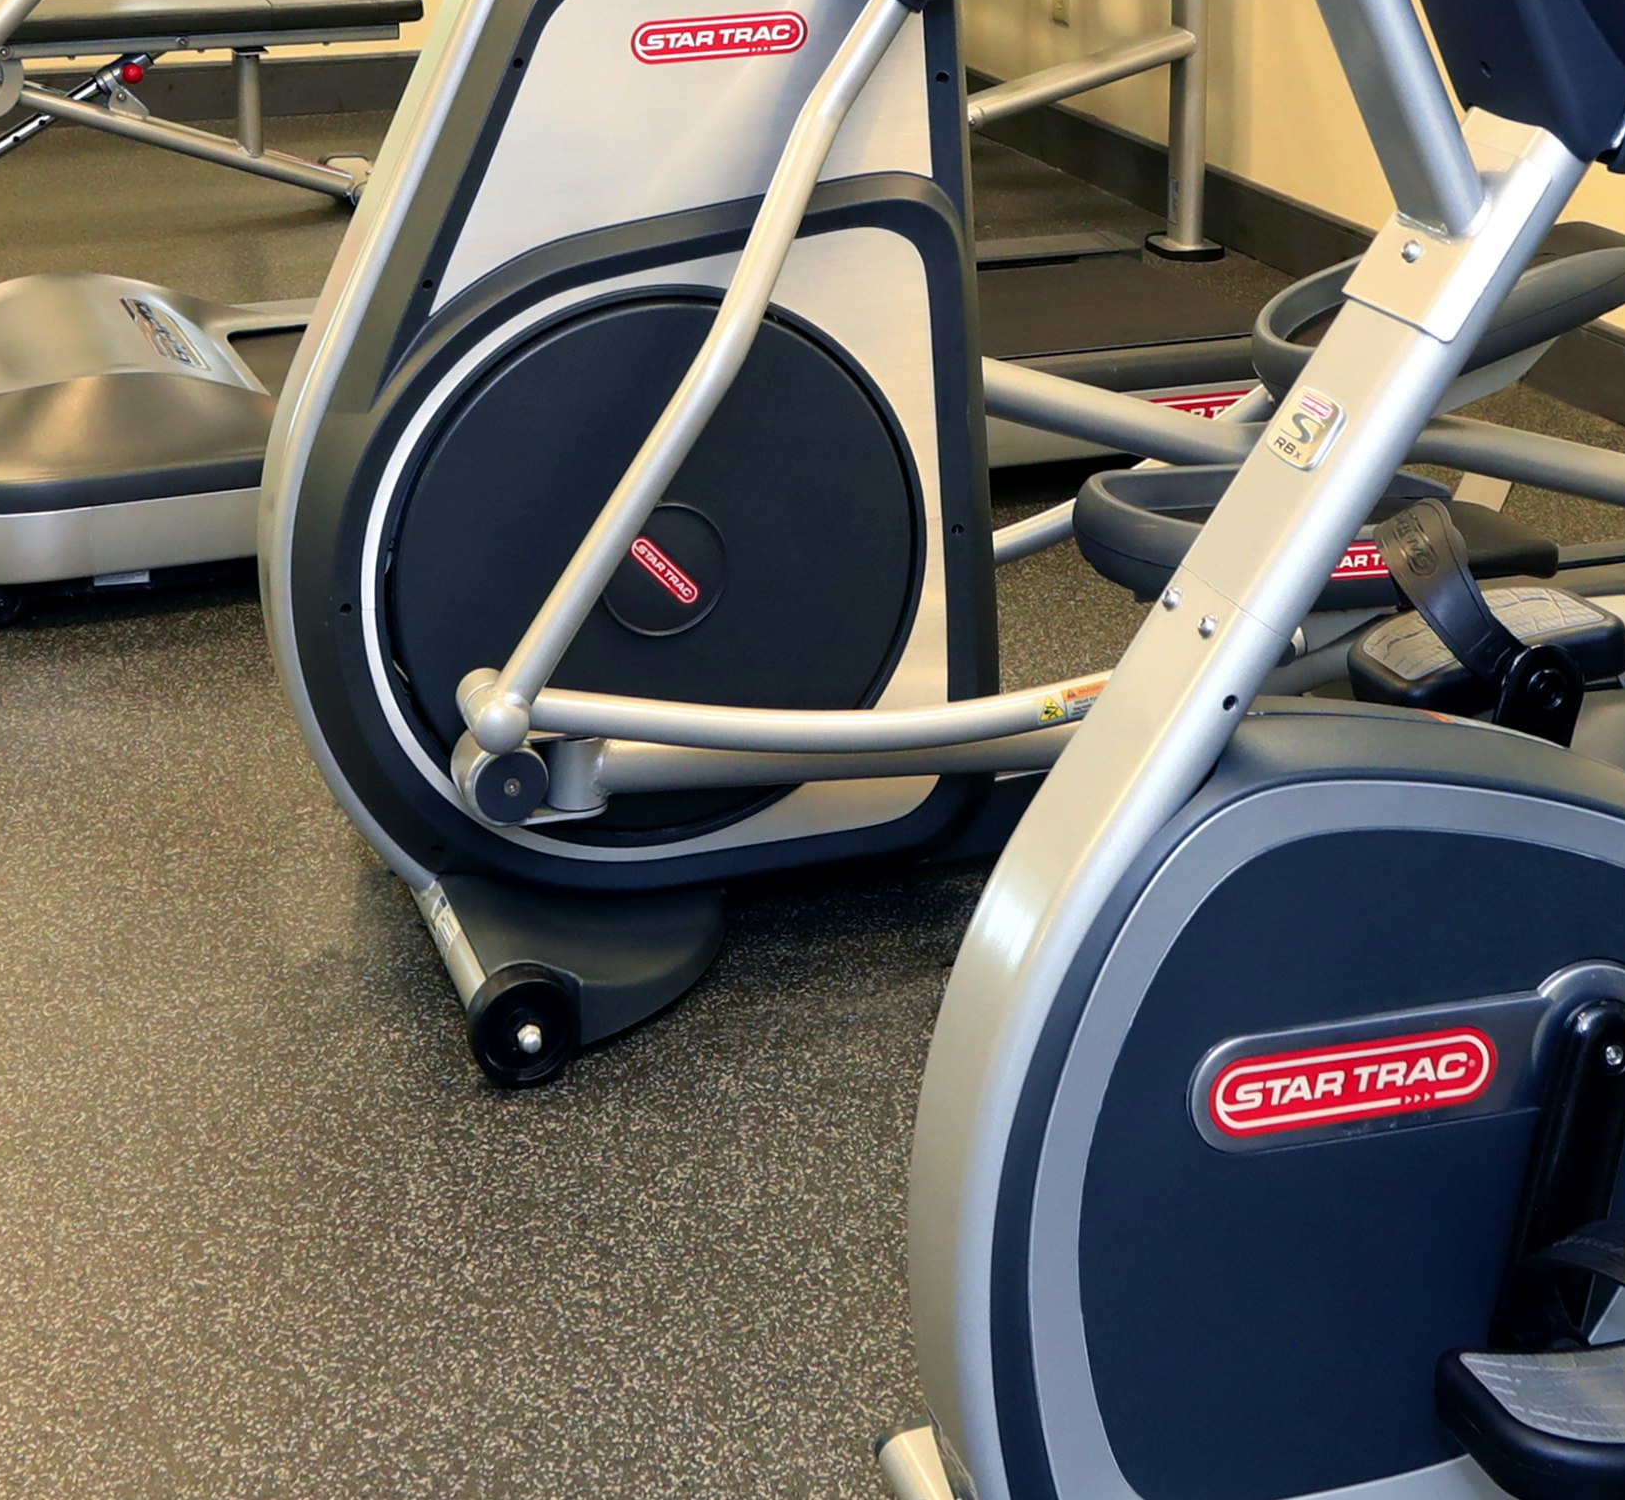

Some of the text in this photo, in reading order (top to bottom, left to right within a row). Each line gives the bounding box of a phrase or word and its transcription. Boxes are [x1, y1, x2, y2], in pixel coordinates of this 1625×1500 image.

[642, 23, 792, 51] STAR TRAC
[635, 543, 694, 599] STAR TRAC
[1338, 553, 1369, 569] AR
[1225, 1051, 1469, 1113] STAR TRAC
